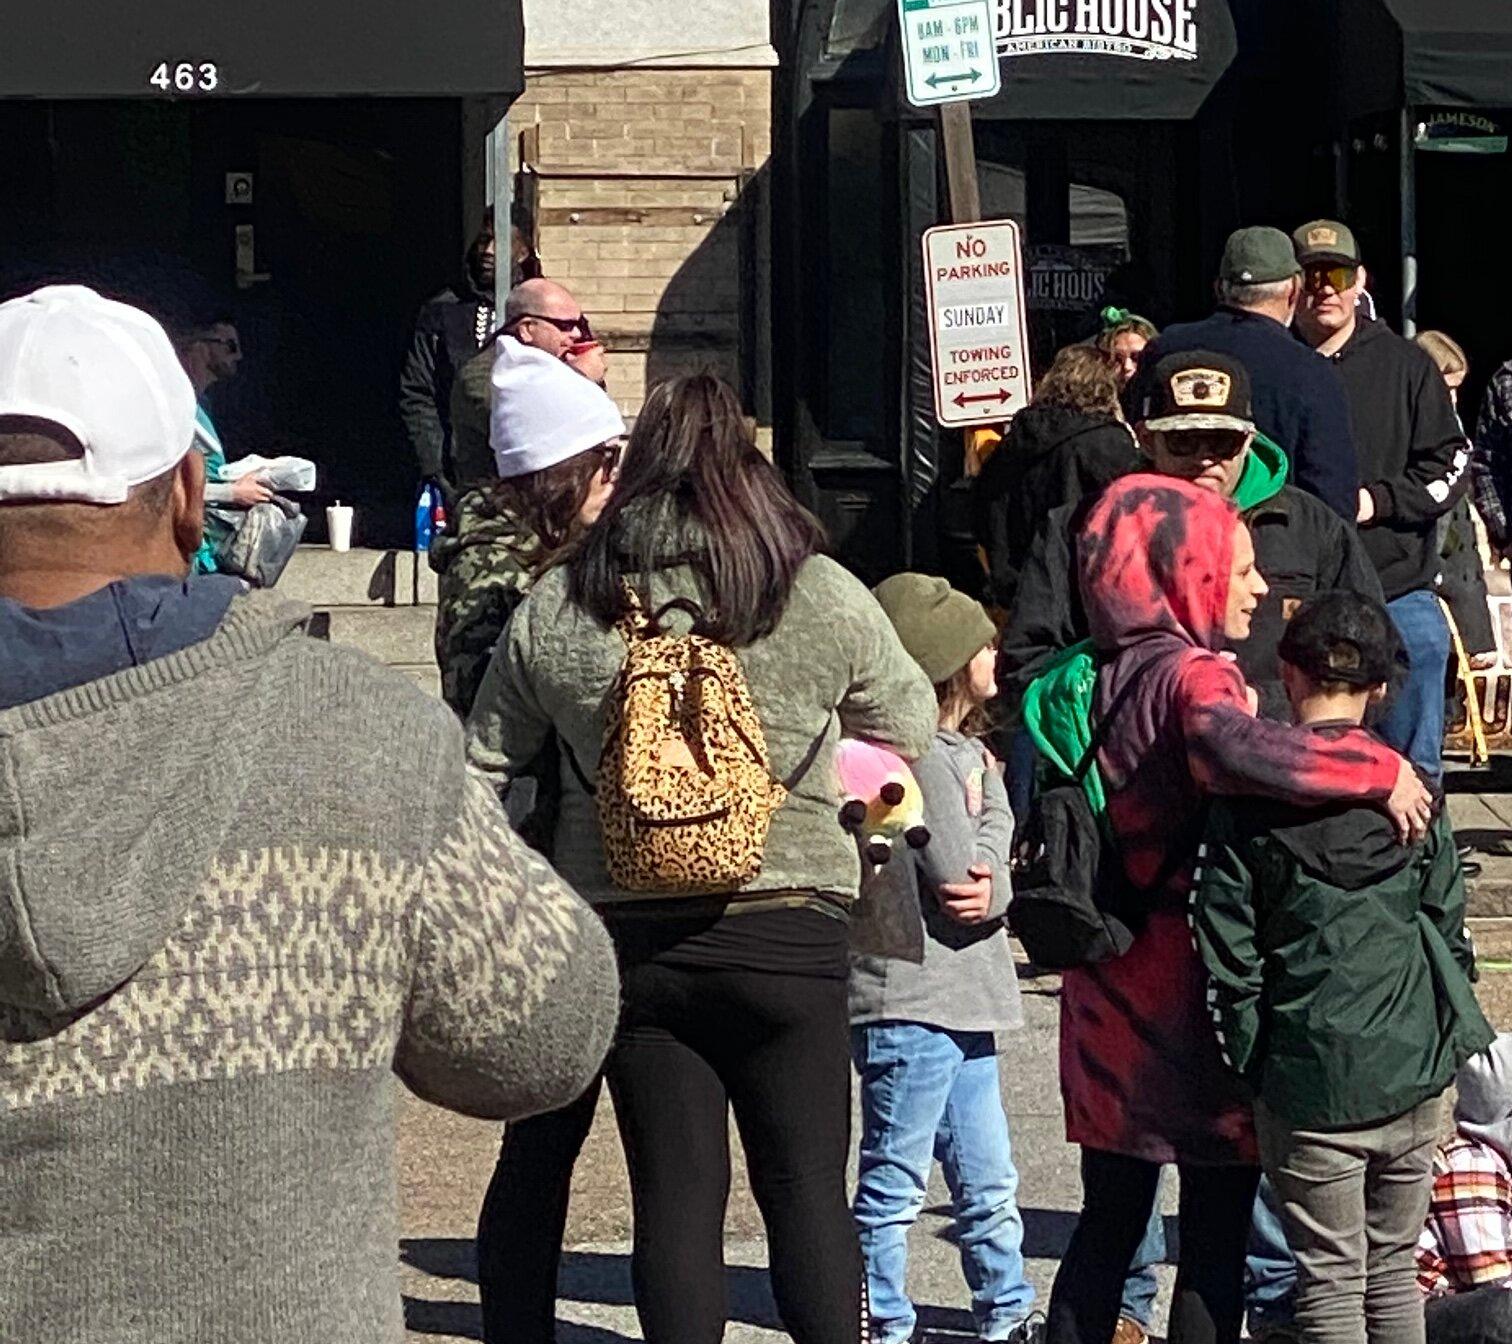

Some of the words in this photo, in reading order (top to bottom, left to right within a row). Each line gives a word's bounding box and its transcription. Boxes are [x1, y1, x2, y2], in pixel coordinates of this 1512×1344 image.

[954, 15, 979, 35] 6PM
[922, 45, 949, 64] MON
[960, 40, 980, 60] FRI
[150, 62, 218, 91] 463
[1427, 112, 1497, 133] JAMESON
[956, 240, 987, 258] NO
[937, 261, 1010, 282] PARKING
[1053, 270, 1106, 301] HOUS
[943, 305, 1004, 328] SUNDAY
[950, 345, 1011, 364] TOWING
[944, 365, 1019, 386] ENFORCED
